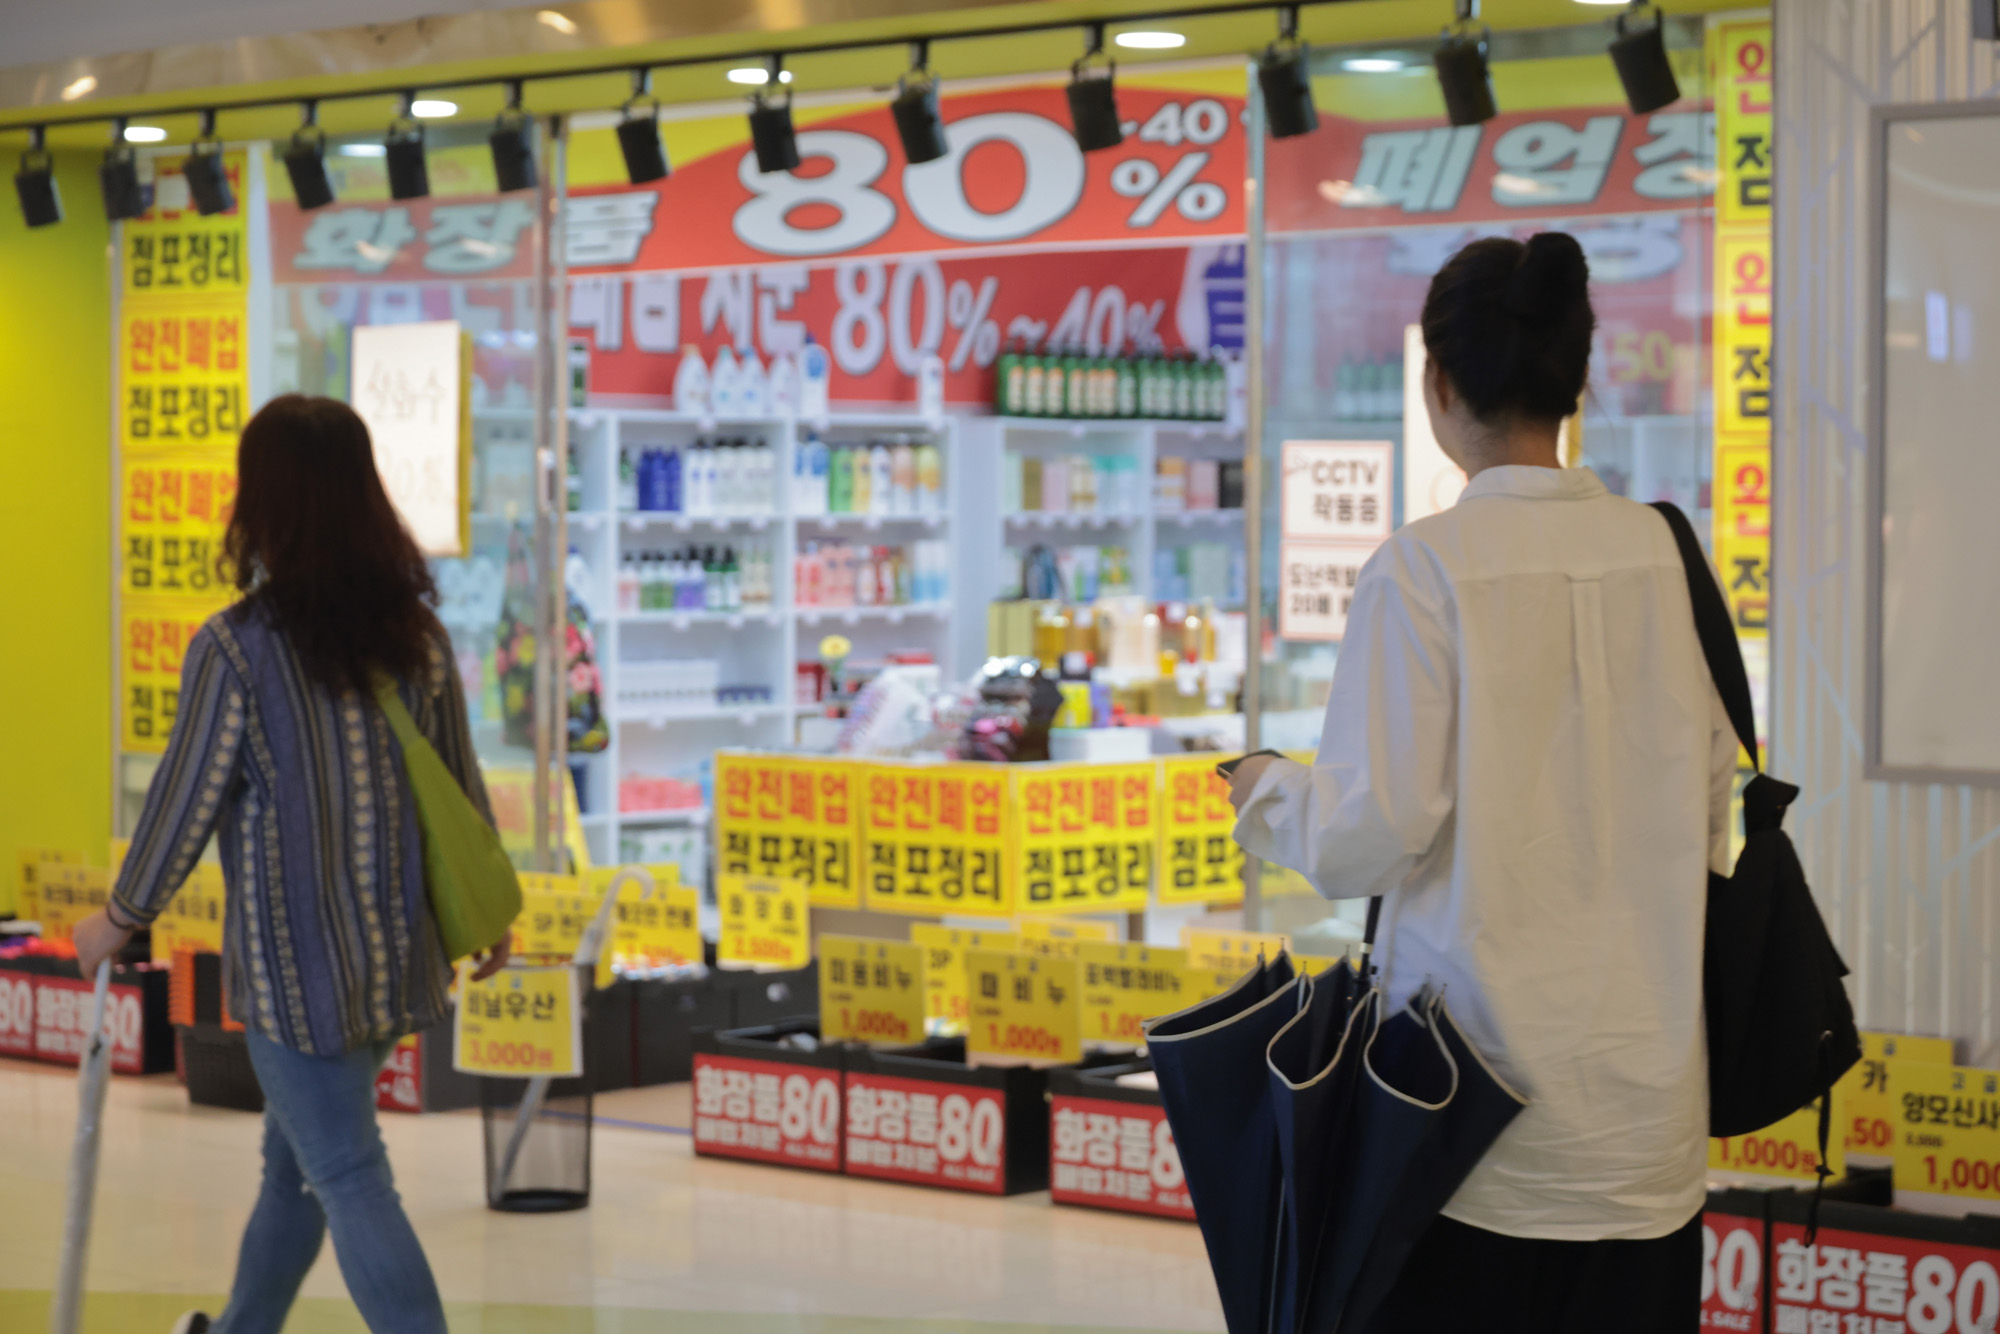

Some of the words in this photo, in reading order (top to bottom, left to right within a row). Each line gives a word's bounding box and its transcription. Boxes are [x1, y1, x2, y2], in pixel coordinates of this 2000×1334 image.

[731, 110, 1086, 257] 80
[131, 230, 241, 288] 점포정리
[129, 317, 240, 374] 완전폐업
[128, 384, 241, 438] 점포정리
[1311, 459, 1379, 486] CCTV
[725, 767, 848, 825] 완전폐업
[869, 774, 999, 835] 완전폐업
[1026, 775, 1150, 834] 완전폐업
[727, 832, 849, 889] 점포정리
[871, 843, 1000, 902] 점포정리
[1027, 841, 1153, 902] 점포정리
[695, 1063, 781, 1123] 화장품
[847, 1083, 939, 1145] 화장품
[1053, 1107, 1152, 1171] 화장품
[1776, 1238, 1908, 1316] 화장품
